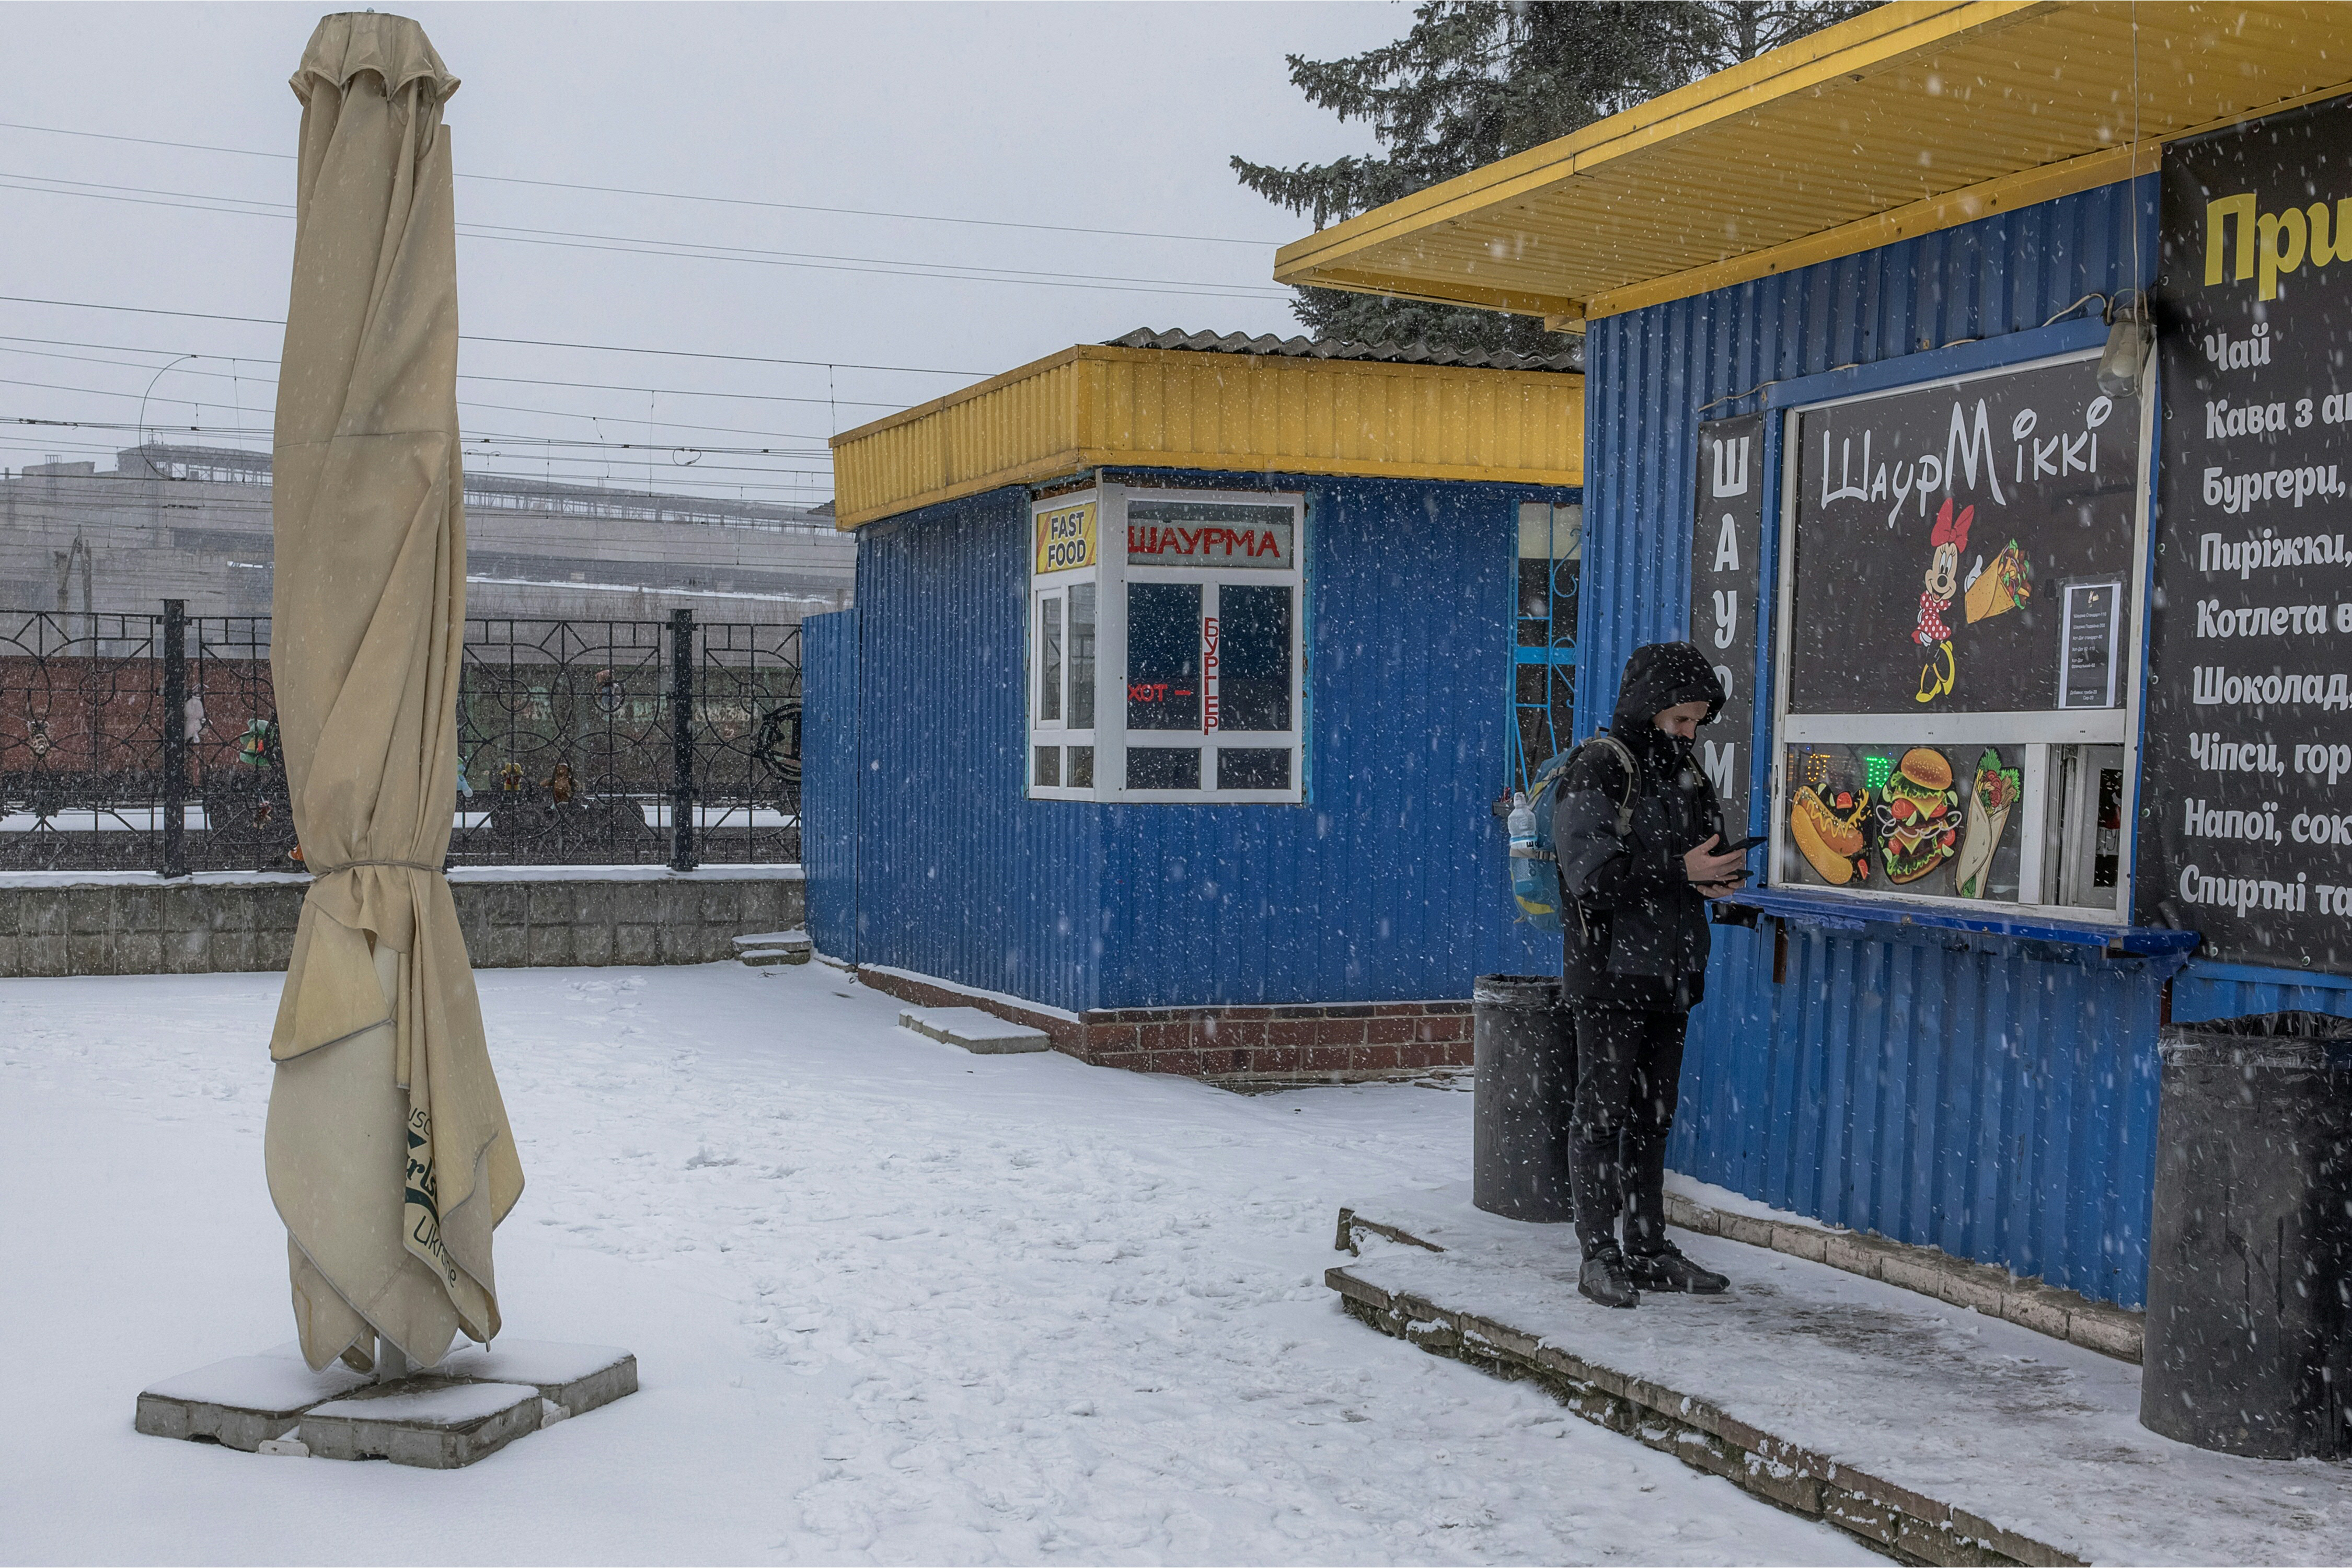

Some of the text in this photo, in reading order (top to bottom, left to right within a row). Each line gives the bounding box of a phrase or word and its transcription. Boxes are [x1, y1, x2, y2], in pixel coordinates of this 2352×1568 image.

[2204, 193, 2352, 302] При
[2203, 322, 2271, 371] Чай
[2205, 392, 2352, 440] Кава з а
[2203, 464, 2346, 514] Бургери,
[1051, 512, 1085, 540] FAST
[1128, 525, 1281, 558] ШАУРМА
[1047, 539, 1087, 568] FOOD
[2199, 528, 2352, 580] Пиріжки,
[2197, 599, 2327, 639] Котлета
[1128, 684, 1168, 702] ХОТ
[1204, 617, 1219, 735] БУРГЕР
[2189, 732, 2352, 785] Чіпси, гор
[2185, 798, 2282, 846] Напої,
[2180, 864, 2307, 918] Спиртні
